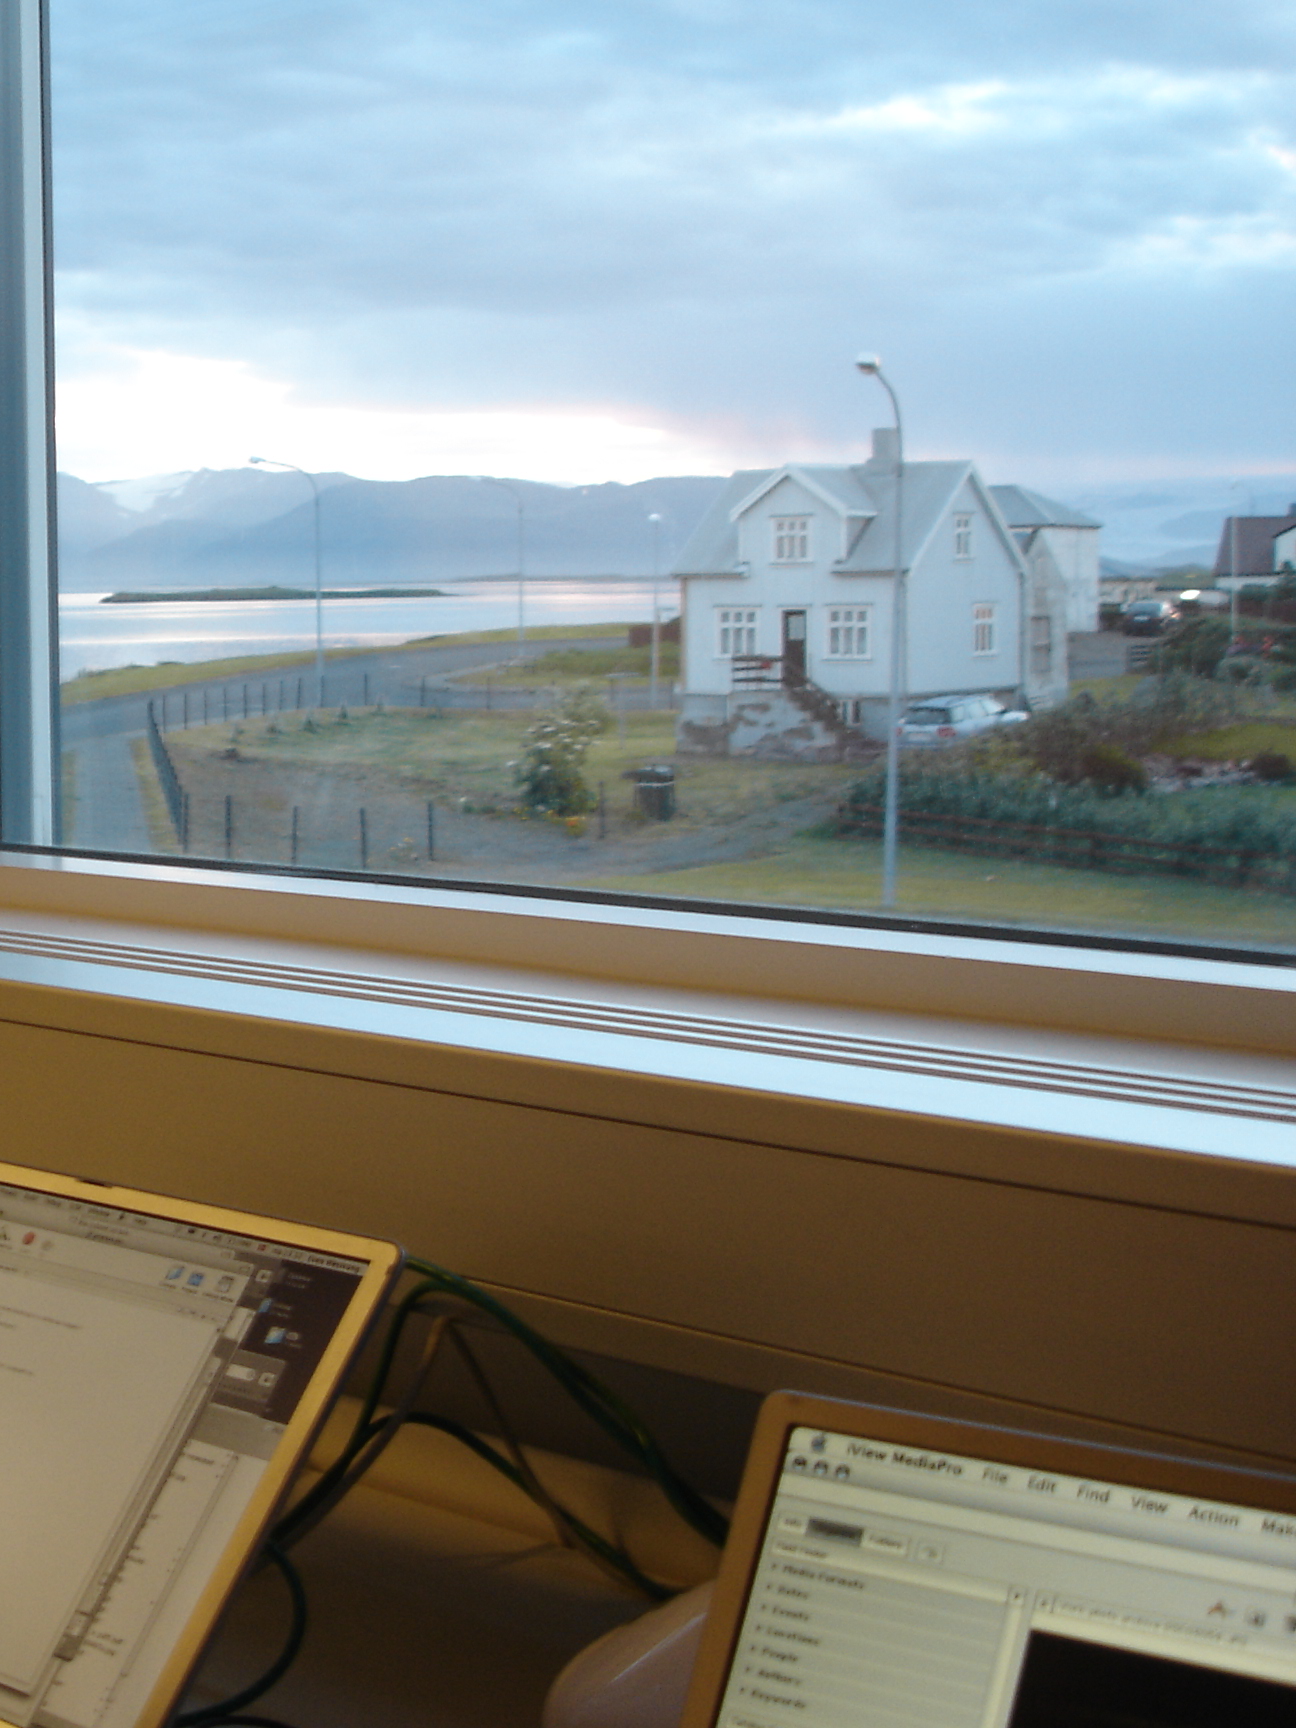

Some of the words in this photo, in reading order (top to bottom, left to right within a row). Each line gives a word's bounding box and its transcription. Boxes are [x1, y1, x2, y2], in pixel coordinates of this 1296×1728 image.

[891, 1451, 963, 1476] MediaPro
[982, 1467, 1008, 1485] File
[1027, 1474, 1057, 1493] Edit
[1076, 1484, 1110, 1503] Find
[1131, 1496, 1169, 1514] View
[1188, 1506, 1240, 1527] Action
